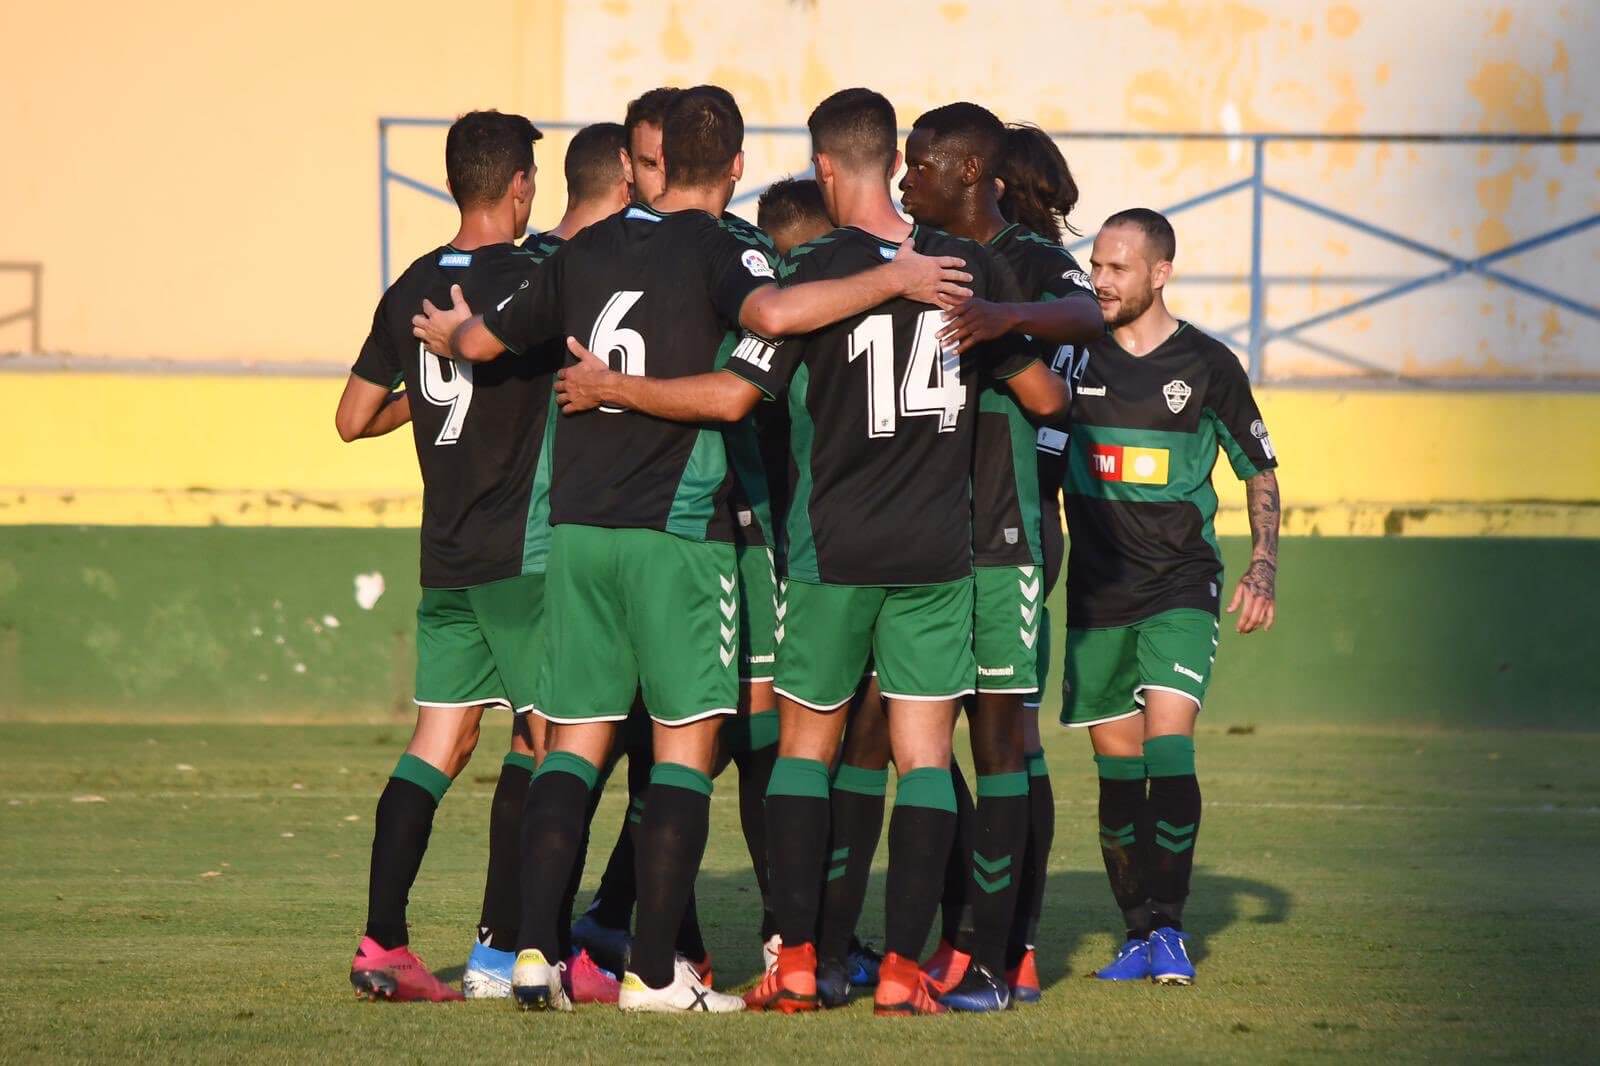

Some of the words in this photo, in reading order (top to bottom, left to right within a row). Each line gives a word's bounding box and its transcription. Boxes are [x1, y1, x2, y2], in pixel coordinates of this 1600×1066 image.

[419, 338, 473, 446] 9
[588, 290, 645, 414] 6
[848, 309, 967, 439] 14
[1092, 454, 1116, 473] TM
[977, 664, 1014, 676] hummel
